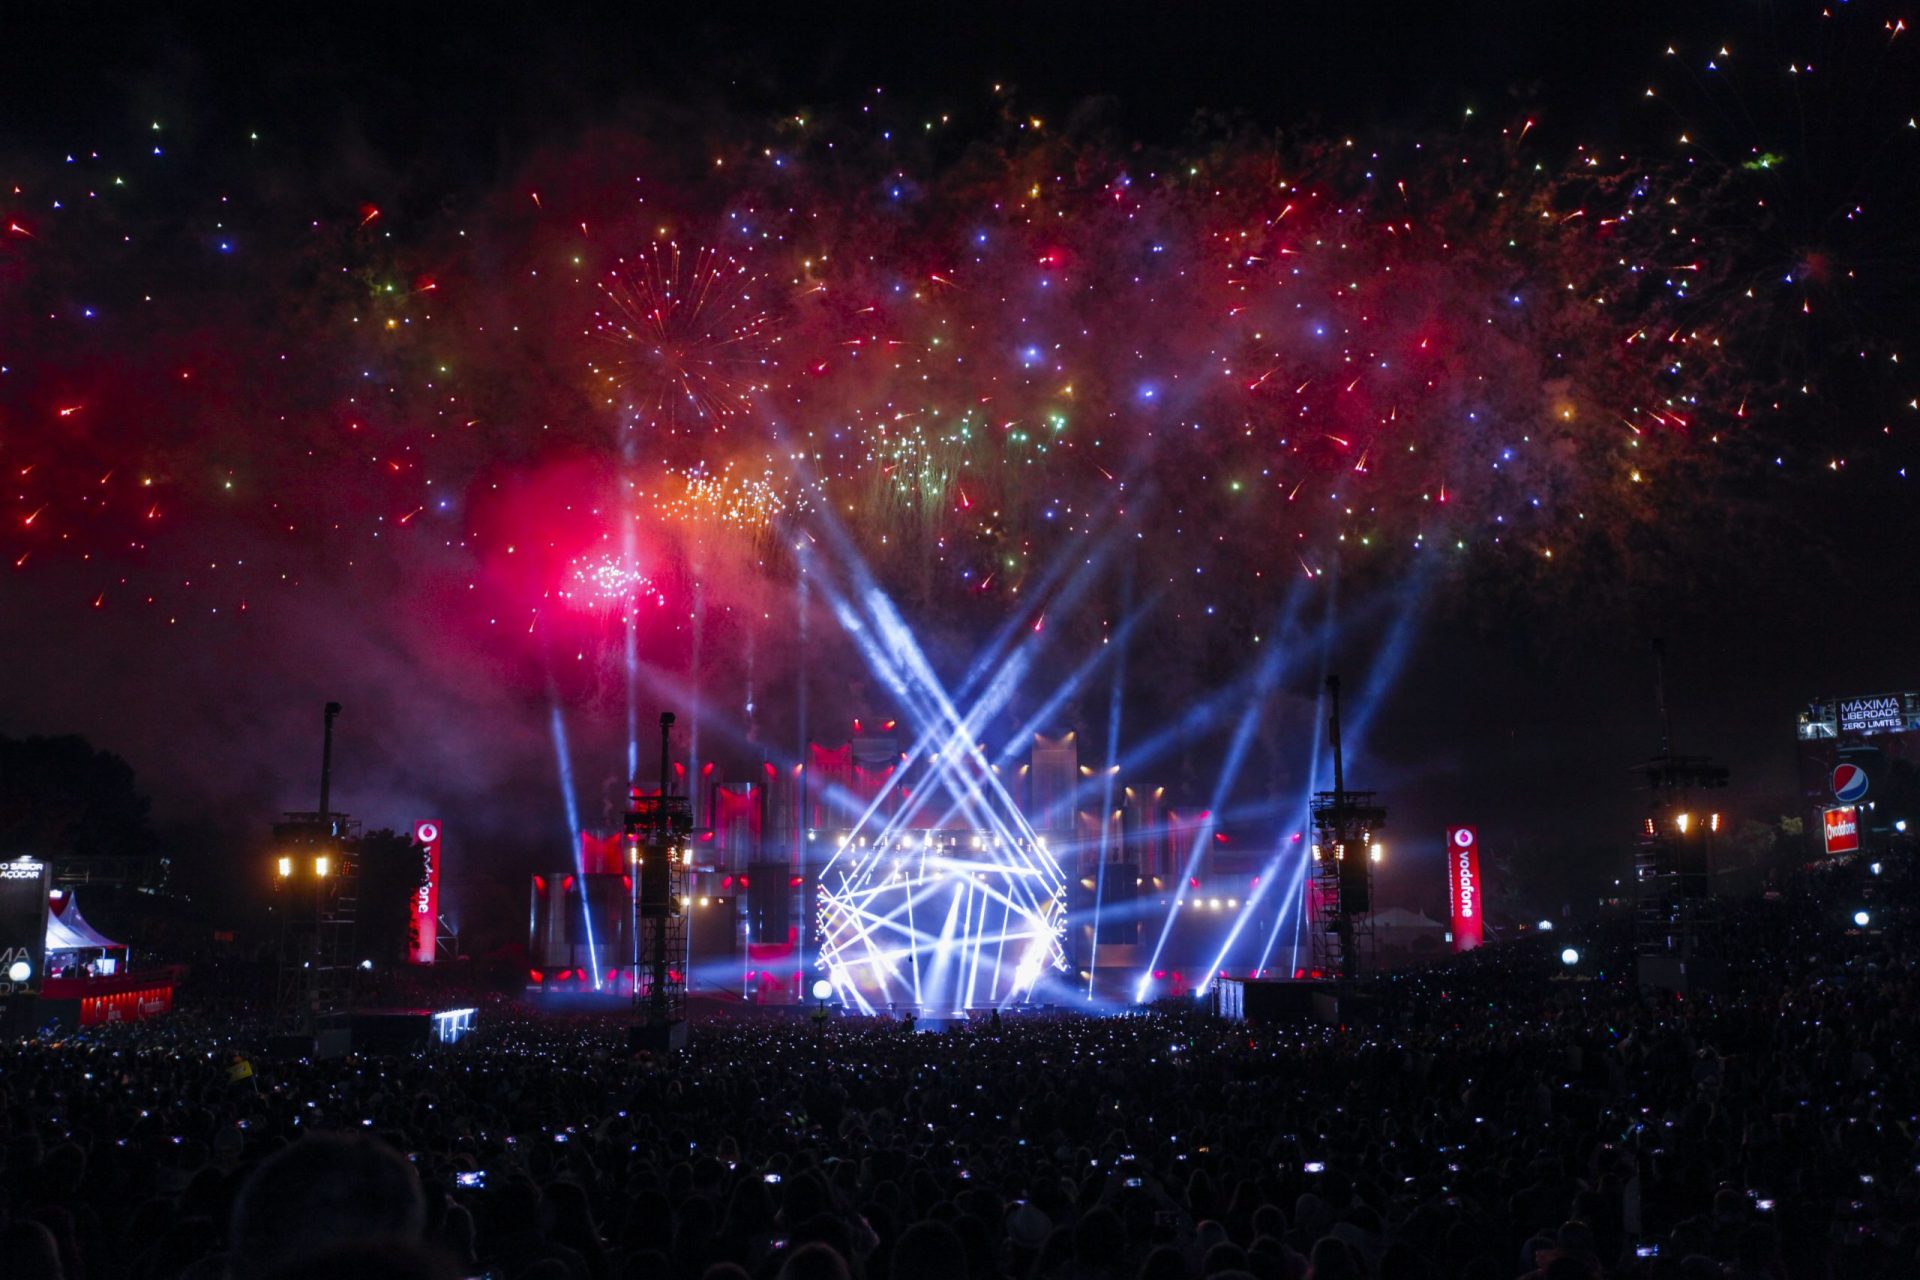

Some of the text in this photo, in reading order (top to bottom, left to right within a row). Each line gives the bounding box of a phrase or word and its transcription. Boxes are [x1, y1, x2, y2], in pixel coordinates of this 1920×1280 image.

[1841, 698, 1899, 713] MÁXIMA
[1842, 718, 1901, 731] ZERO LIMITES
[1832, 820, 1856, 837] vodafone
[1459, 852, 1474, 918] vodafone
